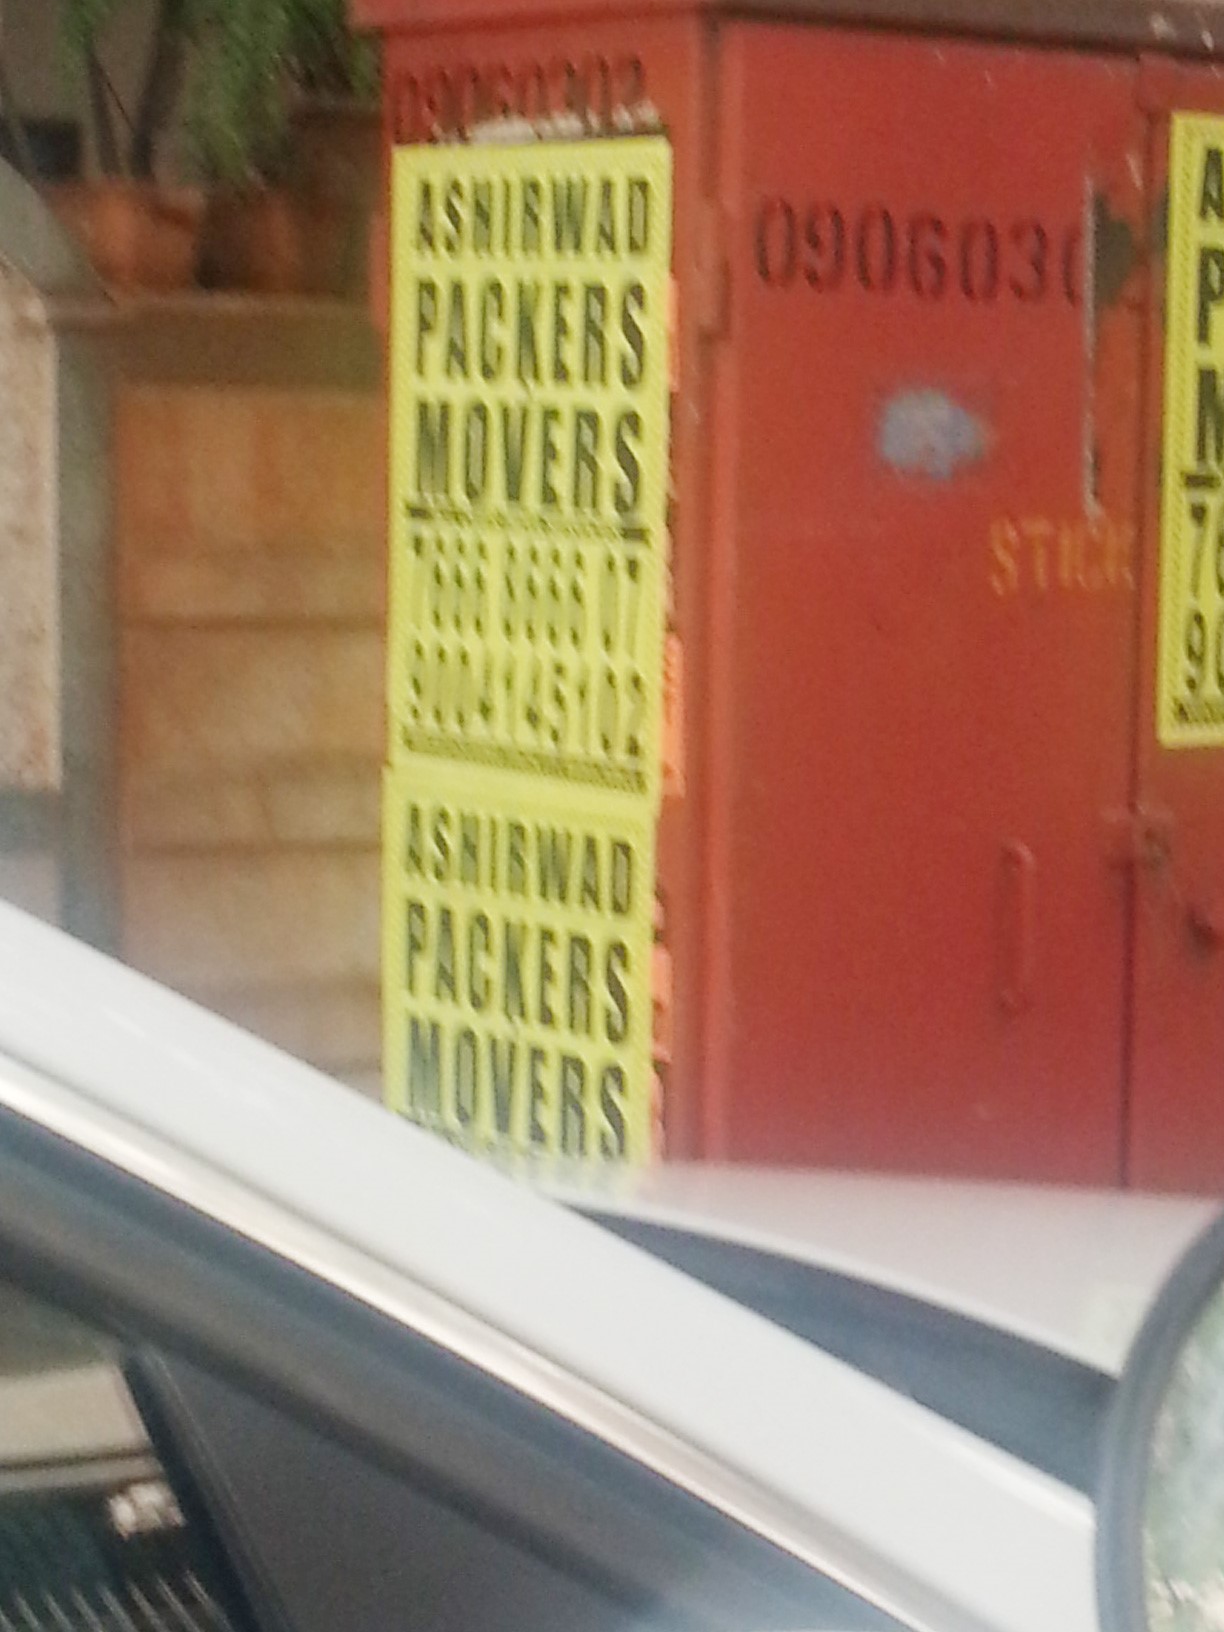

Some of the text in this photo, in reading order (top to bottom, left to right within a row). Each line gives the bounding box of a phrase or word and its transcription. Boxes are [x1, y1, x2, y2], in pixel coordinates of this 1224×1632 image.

[417, 178, 650, 254] ASHIRWAD
[417, 280, 645, 387] PACKERS
[416, 402, 642, 514] MOVERS
[406, 801, 636, 917] ASHIRWAD
[406, 900, 630, 1044] PACKERS
[408, 1017, 627, 1160] MOVERS
